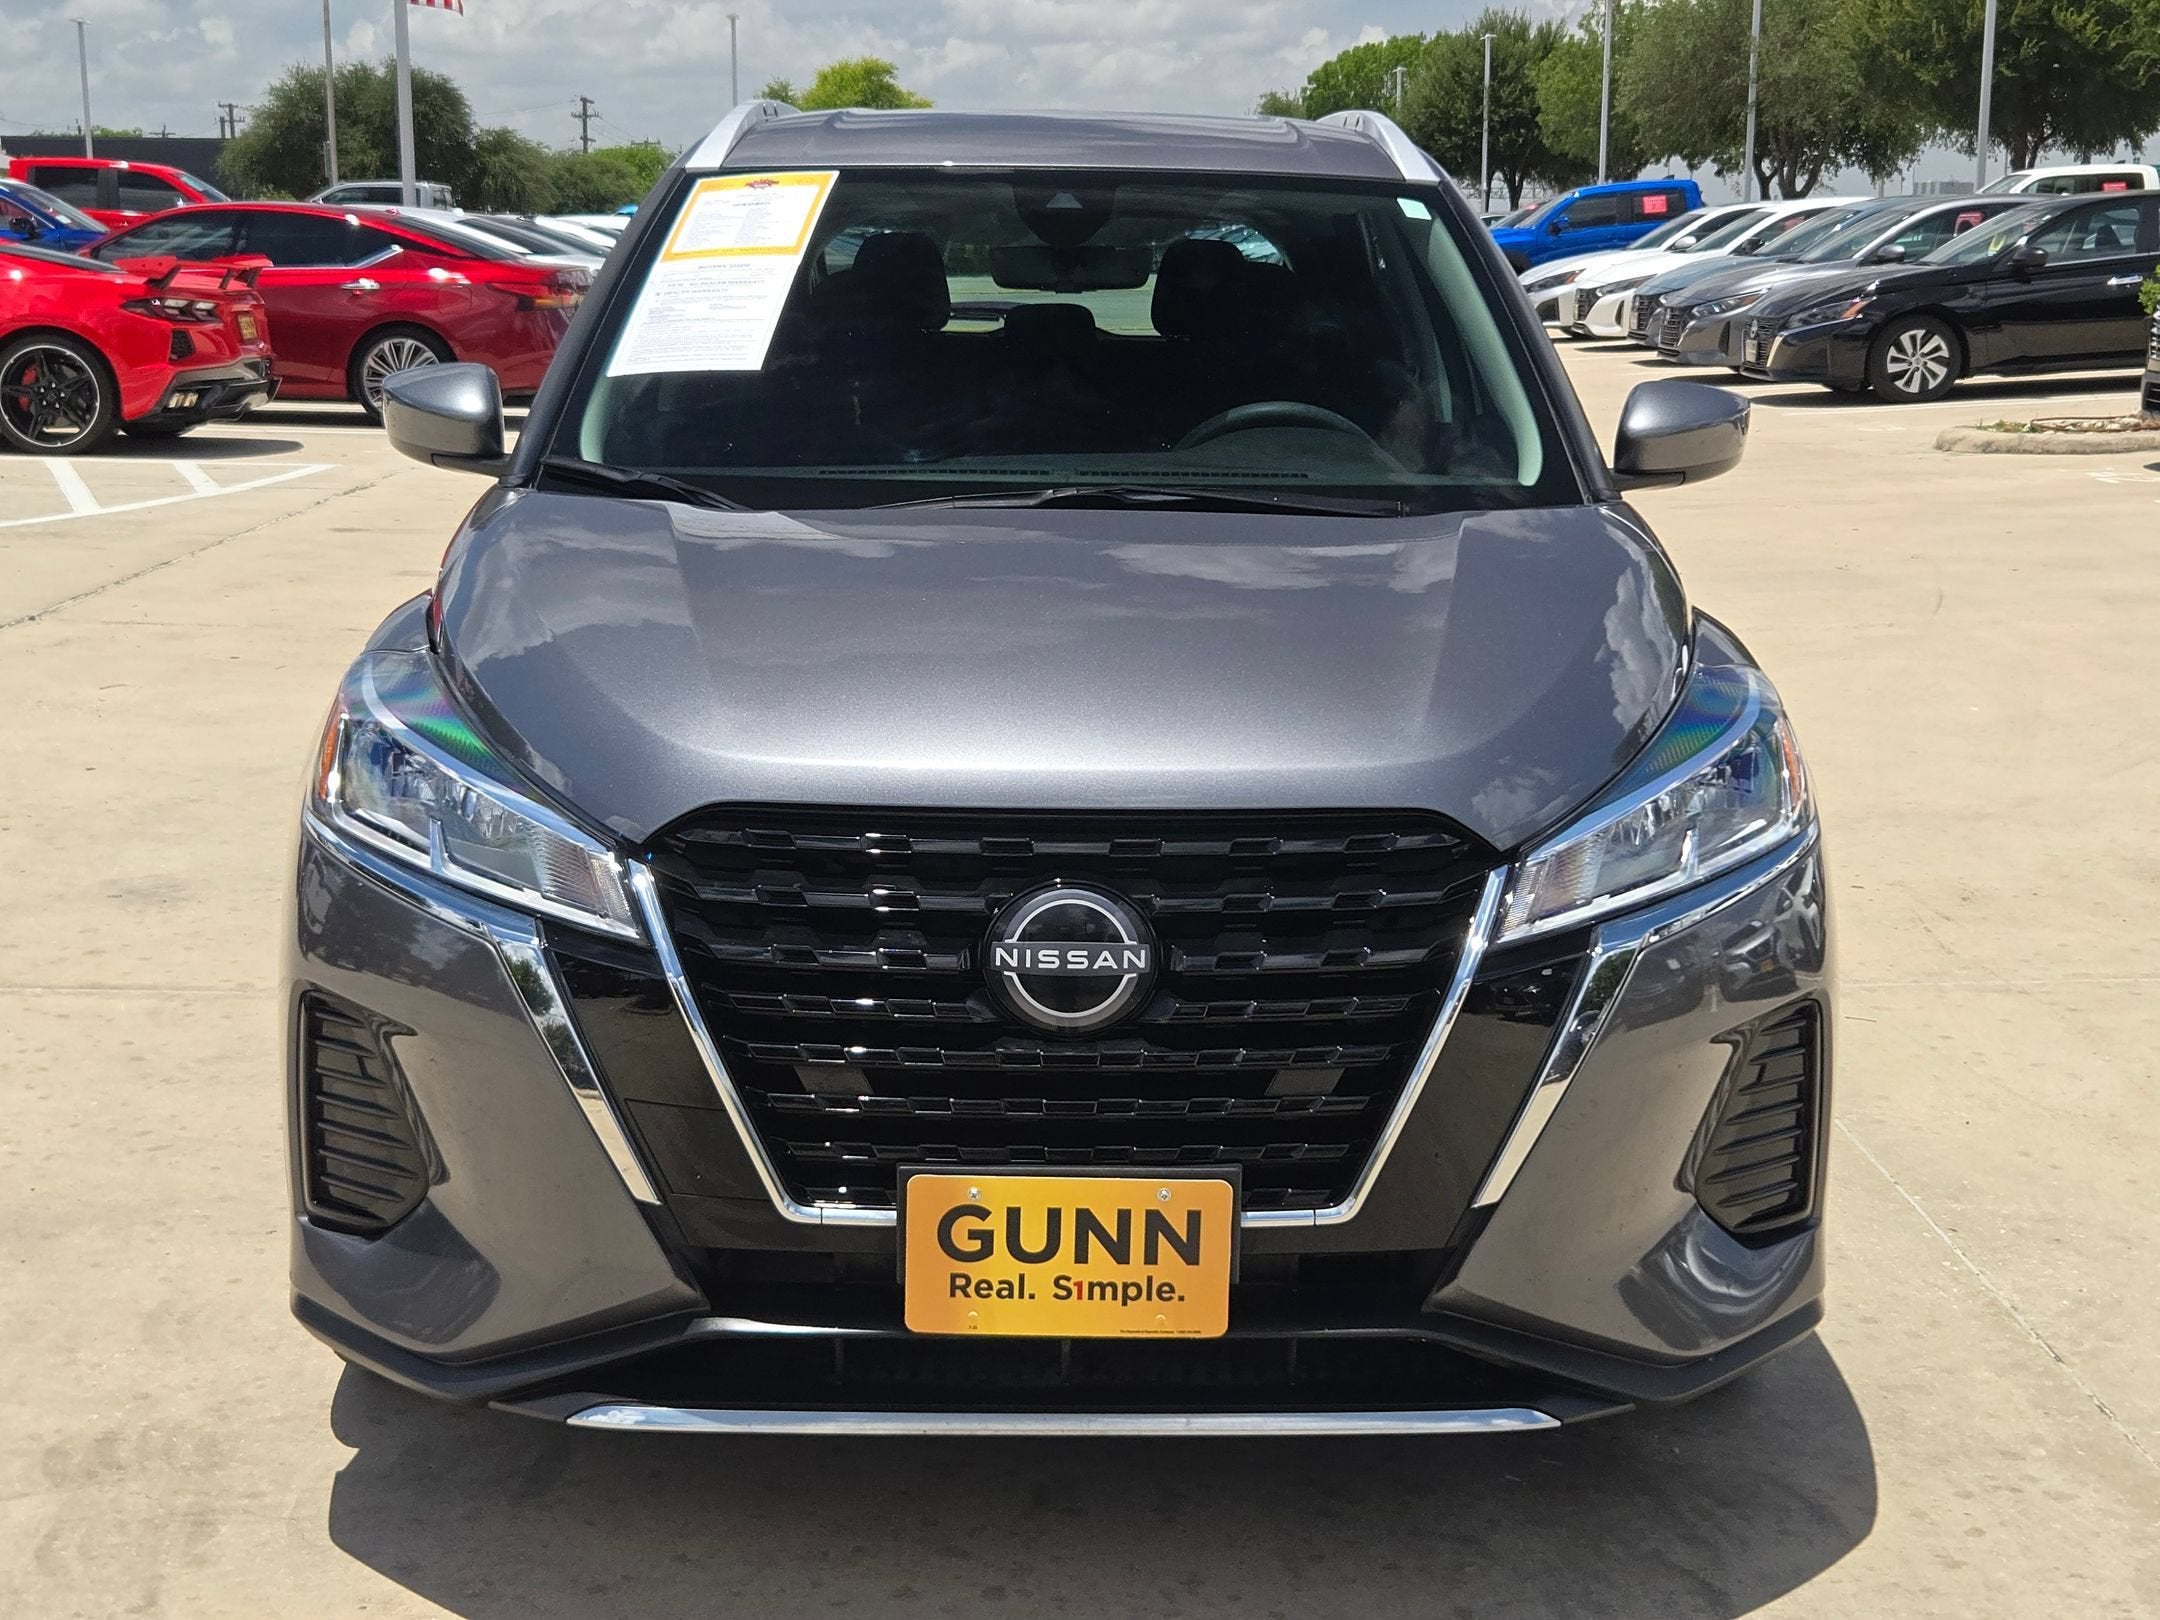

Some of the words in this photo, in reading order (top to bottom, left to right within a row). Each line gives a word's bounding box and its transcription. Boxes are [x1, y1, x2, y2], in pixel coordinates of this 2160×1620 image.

[995, 947, 1146, 970] NISSAN
[936, 1203, 1202, 1266] GUNN
[949, 1272, 1036, 1300] Real.
